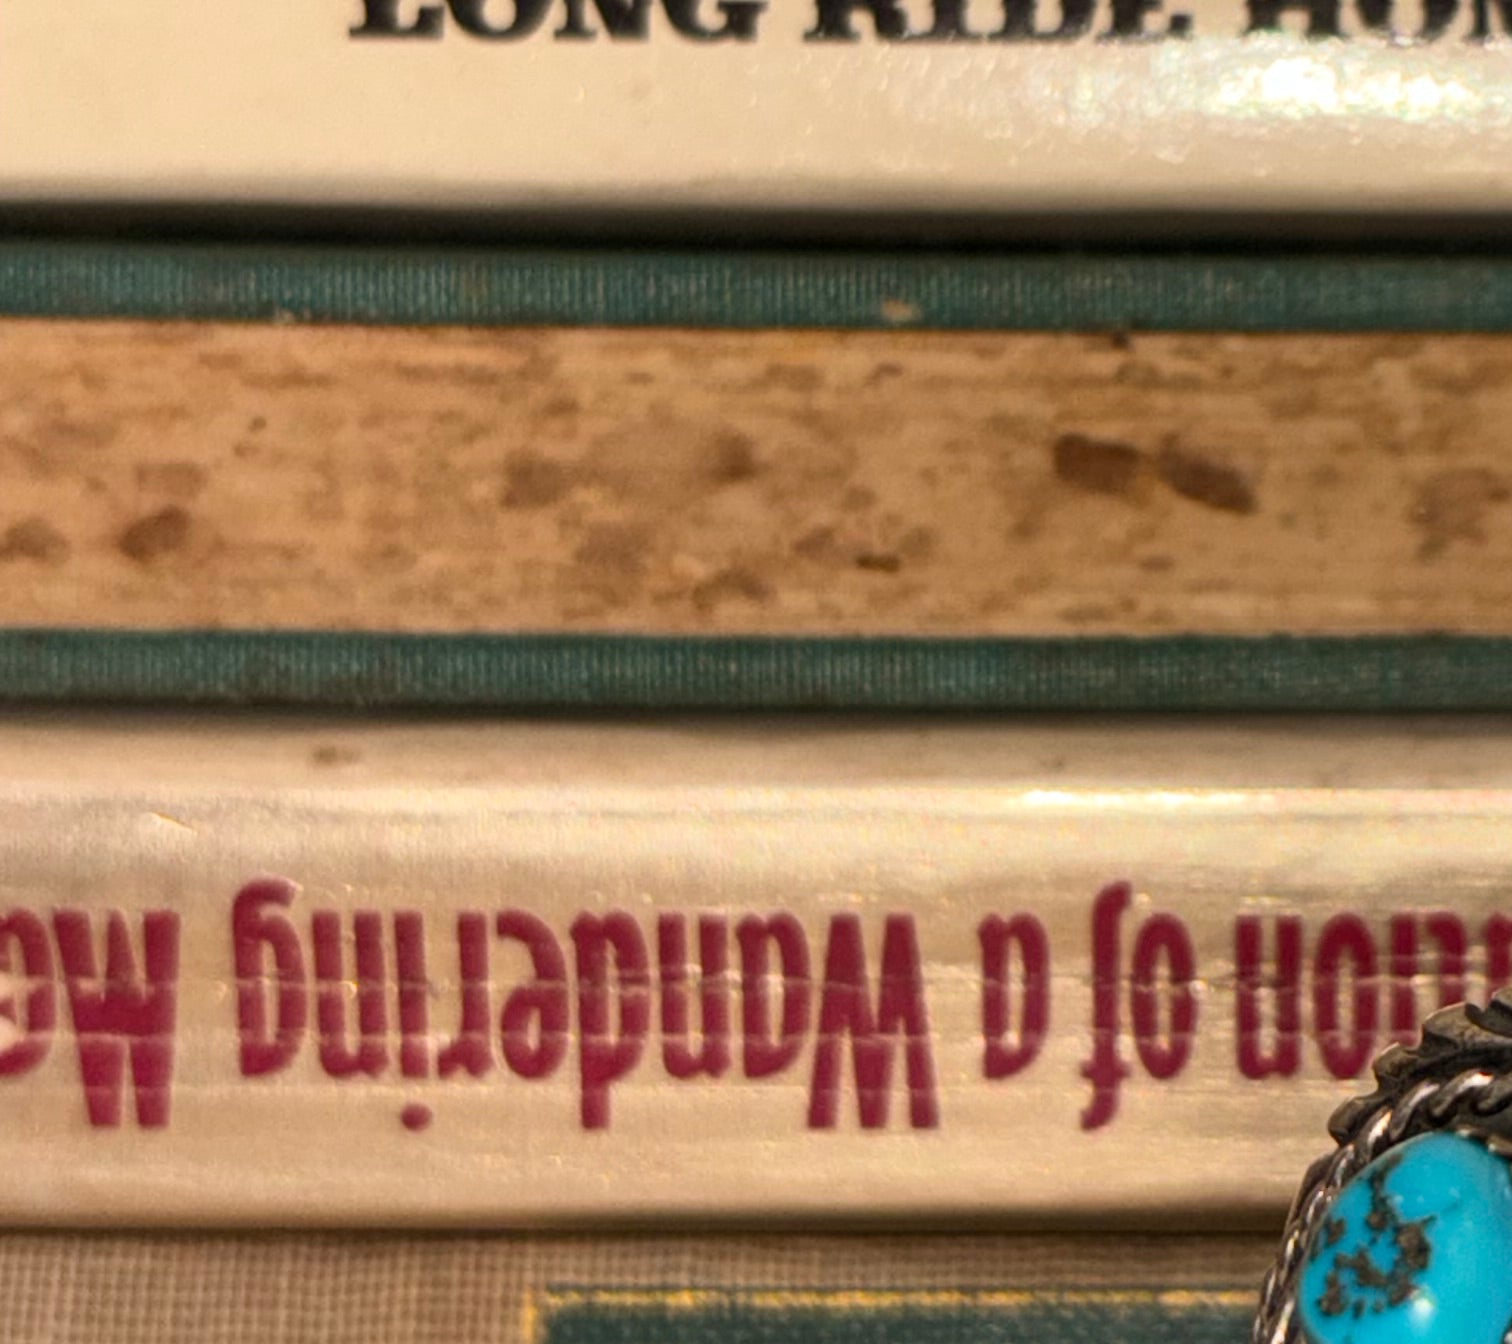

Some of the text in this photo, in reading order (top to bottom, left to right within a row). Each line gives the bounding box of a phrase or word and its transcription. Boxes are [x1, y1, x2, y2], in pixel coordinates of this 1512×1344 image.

[233, 883, 935, 1127] Wandering
[981, 917, 1048, 1077] a
[1085, 885, 1197, 1126] of
